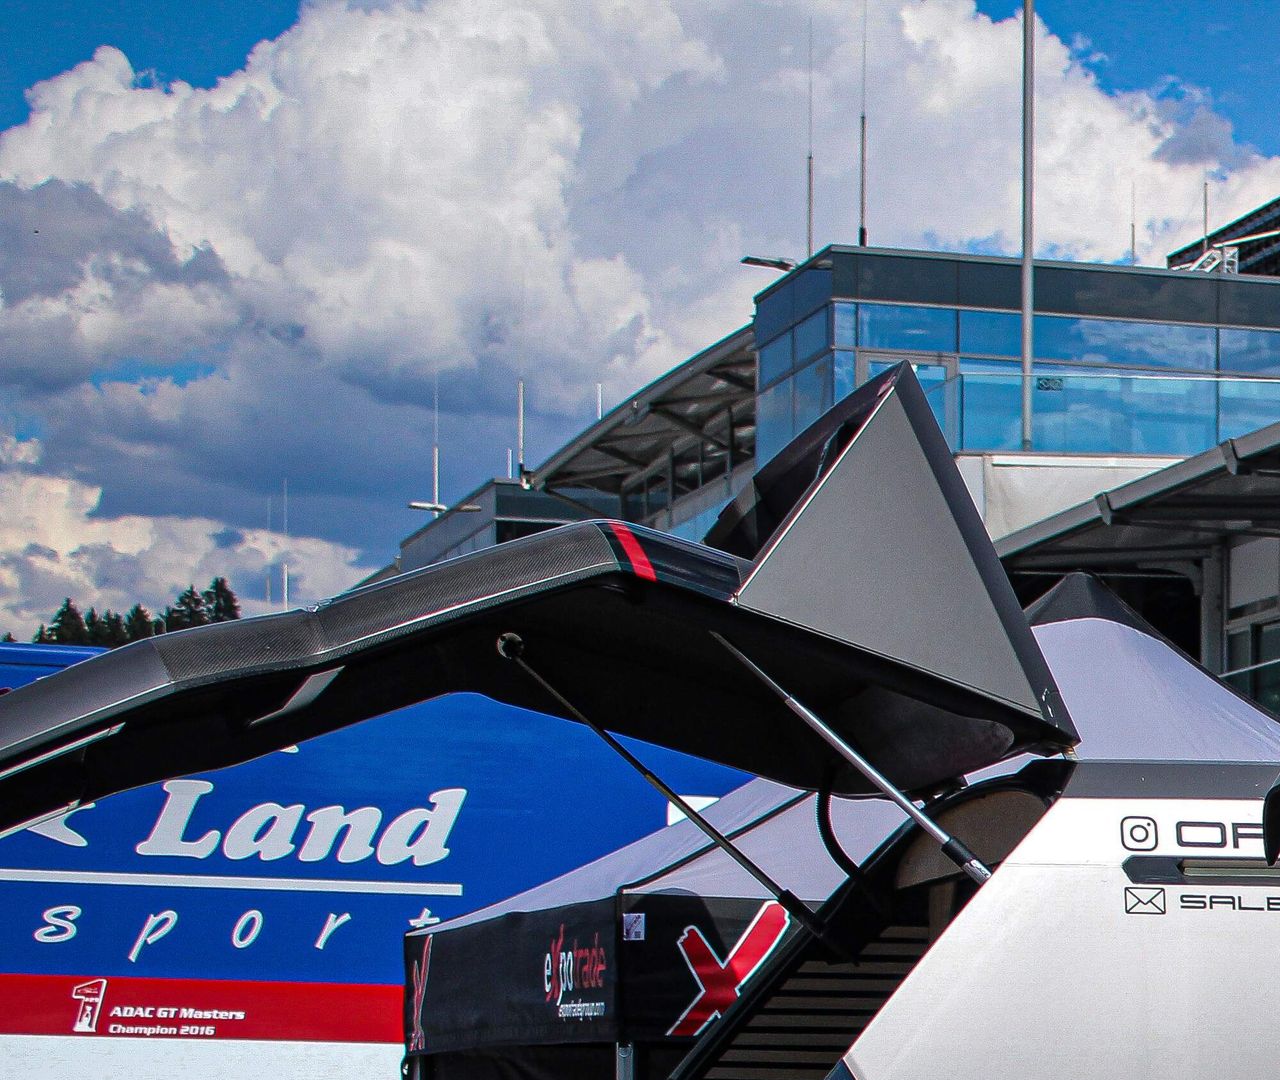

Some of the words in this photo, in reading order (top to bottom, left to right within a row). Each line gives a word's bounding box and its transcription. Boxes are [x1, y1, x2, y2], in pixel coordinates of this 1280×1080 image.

[136, 779, 467, 867] Land
[109, 1006, 155, 1018] ADAC
[156, 1007, 178, 1018] GT
[179, 1007, 246, 1020] Masters
[108, 1024, 177, 1036] Champion
[179, 1025, 215, 1036] 2016
